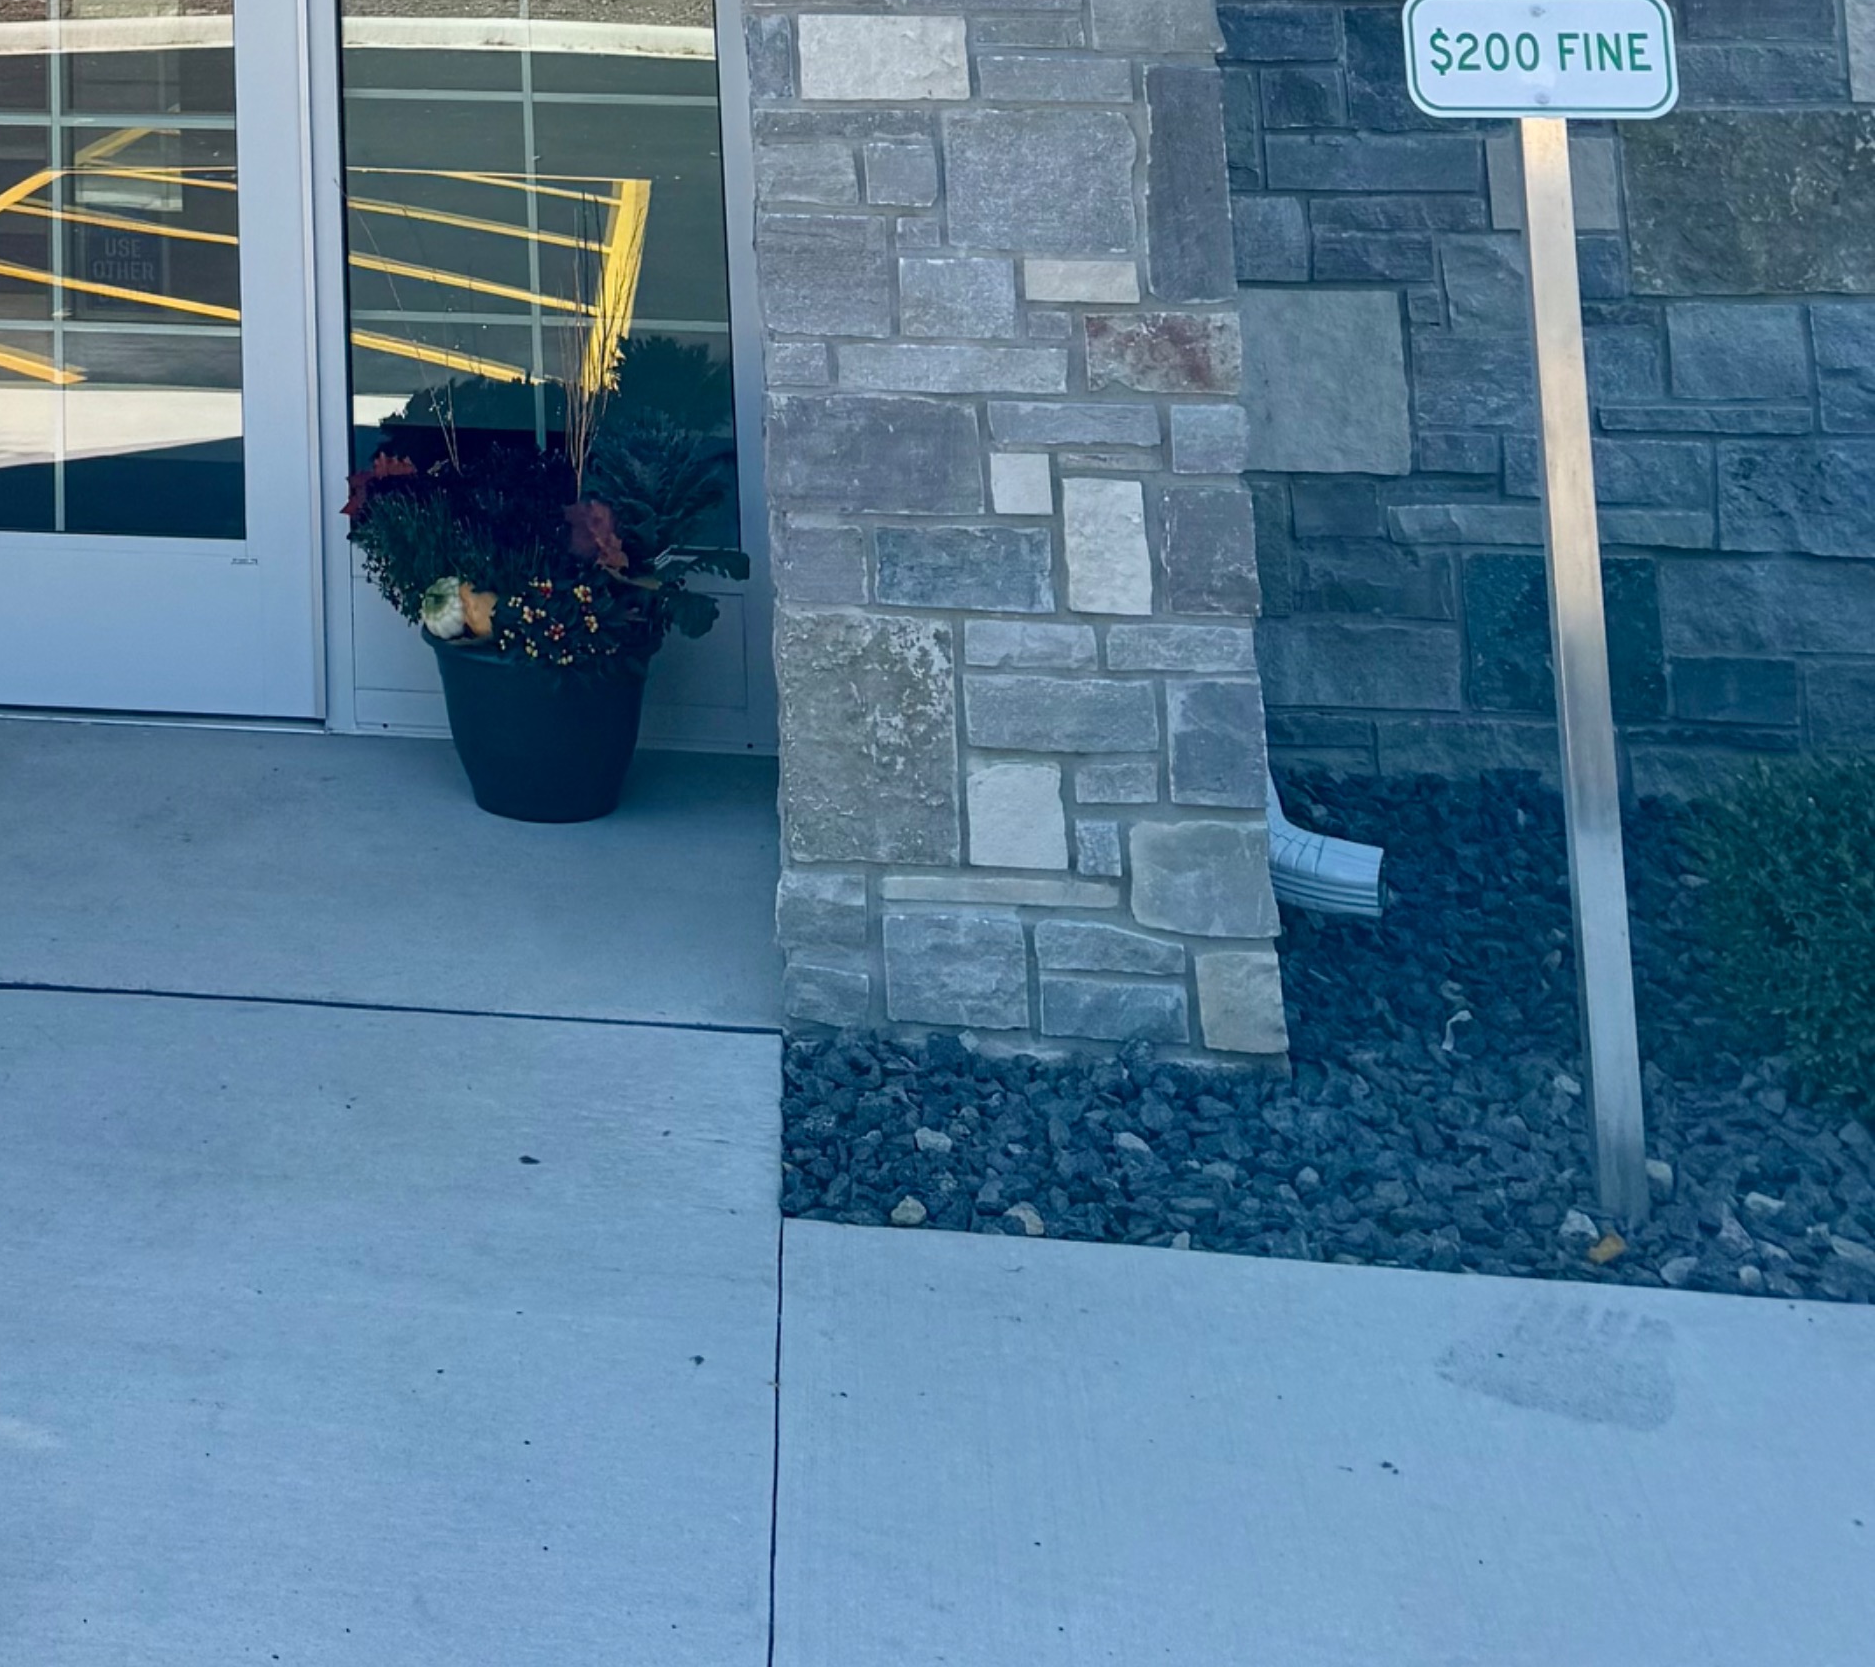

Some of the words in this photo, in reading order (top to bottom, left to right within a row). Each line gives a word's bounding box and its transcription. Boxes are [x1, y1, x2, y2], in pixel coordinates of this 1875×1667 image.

[1429, 27, 1541, 76] $200
[1557, 32, 1653, 72] FINE
[105, 237, 142, 258] USE
[92, 259, 155, 281] OTHER
